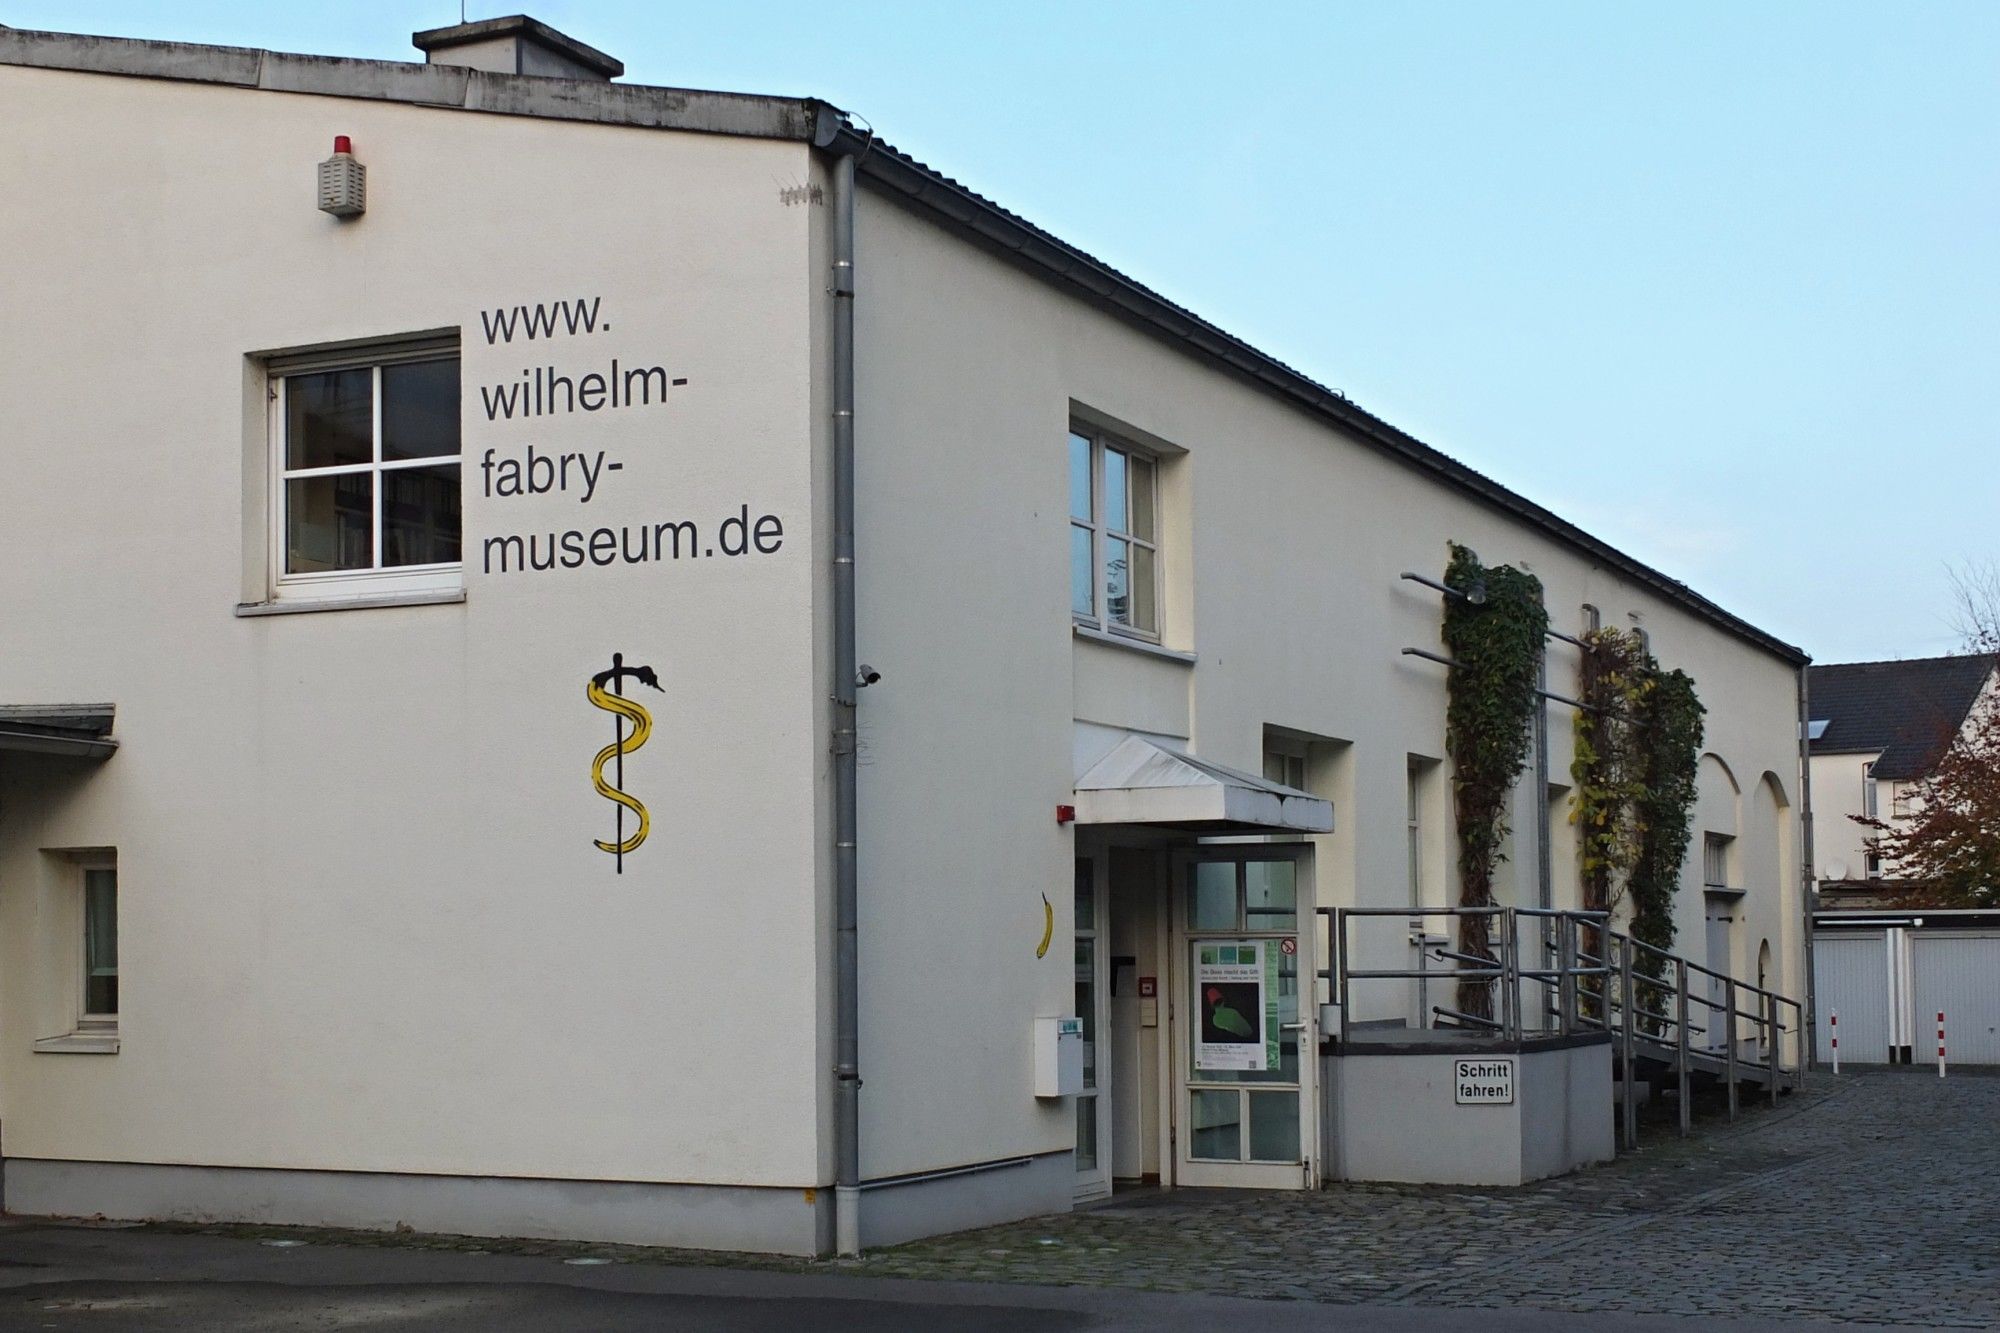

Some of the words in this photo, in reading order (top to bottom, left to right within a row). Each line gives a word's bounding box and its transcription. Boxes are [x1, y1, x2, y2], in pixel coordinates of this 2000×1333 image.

[481, 297, 610, 345] www.
[481, 359, 688, 421] wilhelm-
[481, 445, 623, 503] fabry-
[484, 504, 784, 574] museum.de
[1459, 1063, 1508, 1077] Schritt
[1459, 1083, 1509, 1097] fahren!
